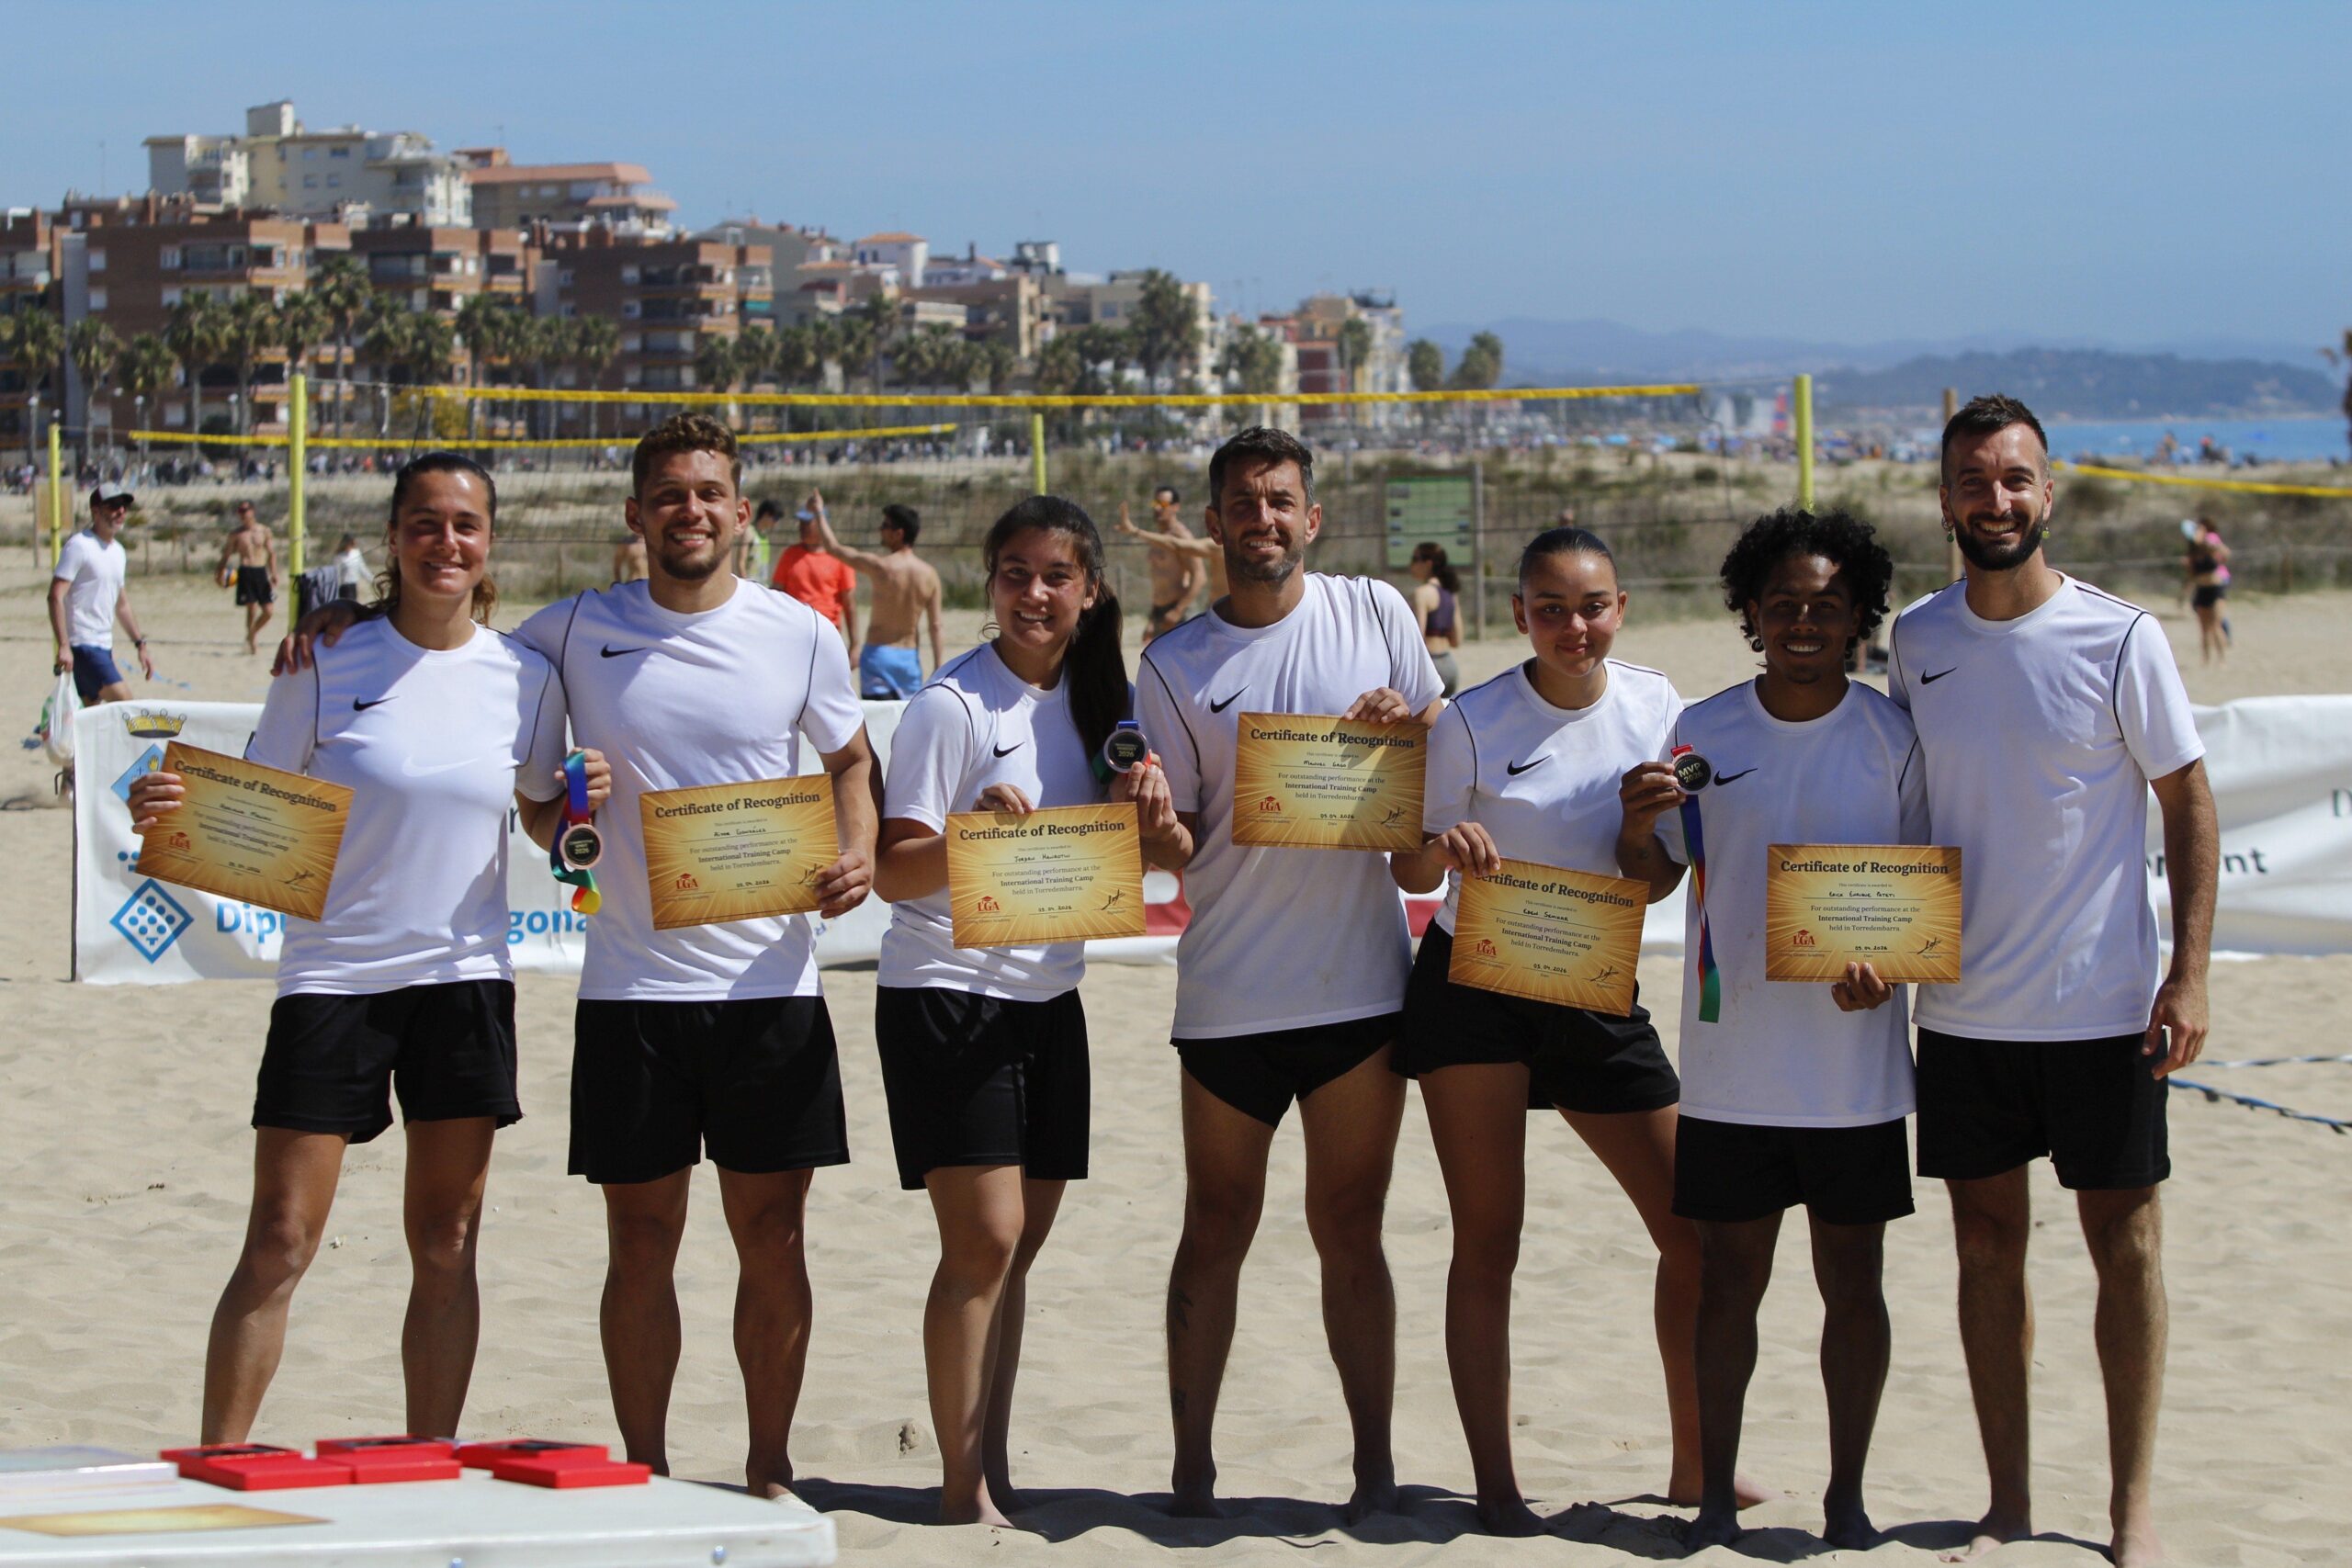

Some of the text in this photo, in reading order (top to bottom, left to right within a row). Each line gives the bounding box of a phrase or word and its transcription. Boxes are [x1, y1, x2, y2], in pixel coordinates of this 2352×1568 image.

[1250, 728, 1413, 748] Certificate of Recognition
[1679, 763, 1701, 777] MVP
[175, 761, 241, 787] Certificate
[243, 781, 259, 791] of
[260, 783, 335, 813] Recognition
[1329, 784, 1357, 793] Training
[656, 793, 820, 818] Certificate of Recognition
[959, 821, 1125, 840] Certificate of Recognition
[1781, 861, 1948, 876] Certificate of Recognition
[1001, 878, 1044, 886] International
[1542, 883, 1556, 893] of
[1557, 885, 1634, 908] Recognition
[1508, 921, 1544, 931] outstanding
[1544, 928, 1582, 937] performance
[1502, 929, 1592, 951] International Training Camp
